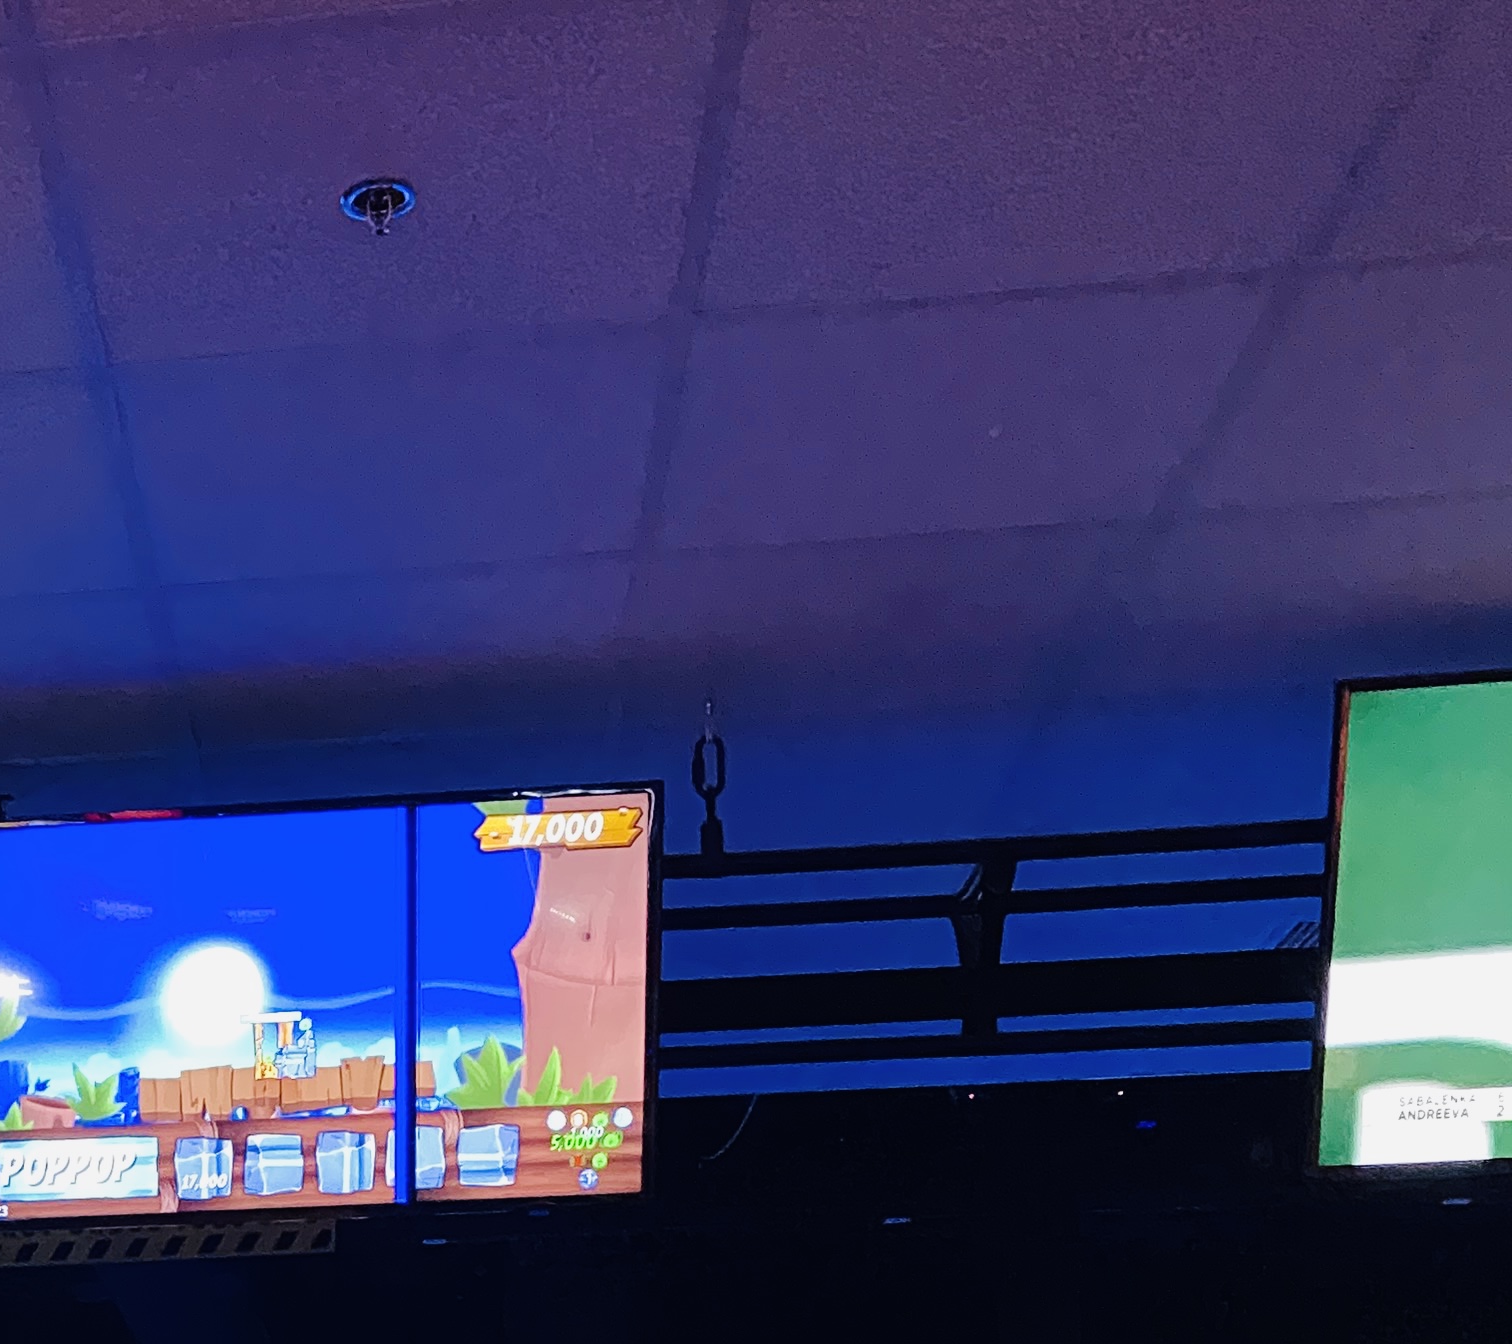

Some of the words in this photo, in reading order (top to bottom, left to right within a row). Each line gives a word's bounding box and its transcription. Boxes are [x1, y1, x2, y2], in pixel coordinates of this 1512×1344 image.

[506, 812, 604, 847] 17,000
[1397, 1107, 1470, 1121] ANDREEVA
[1496, 1105, 1505, 1118] 2
[550, 1133, 598, 1153] 5,000
[0, 1150, 138, 1188] POPPOP
